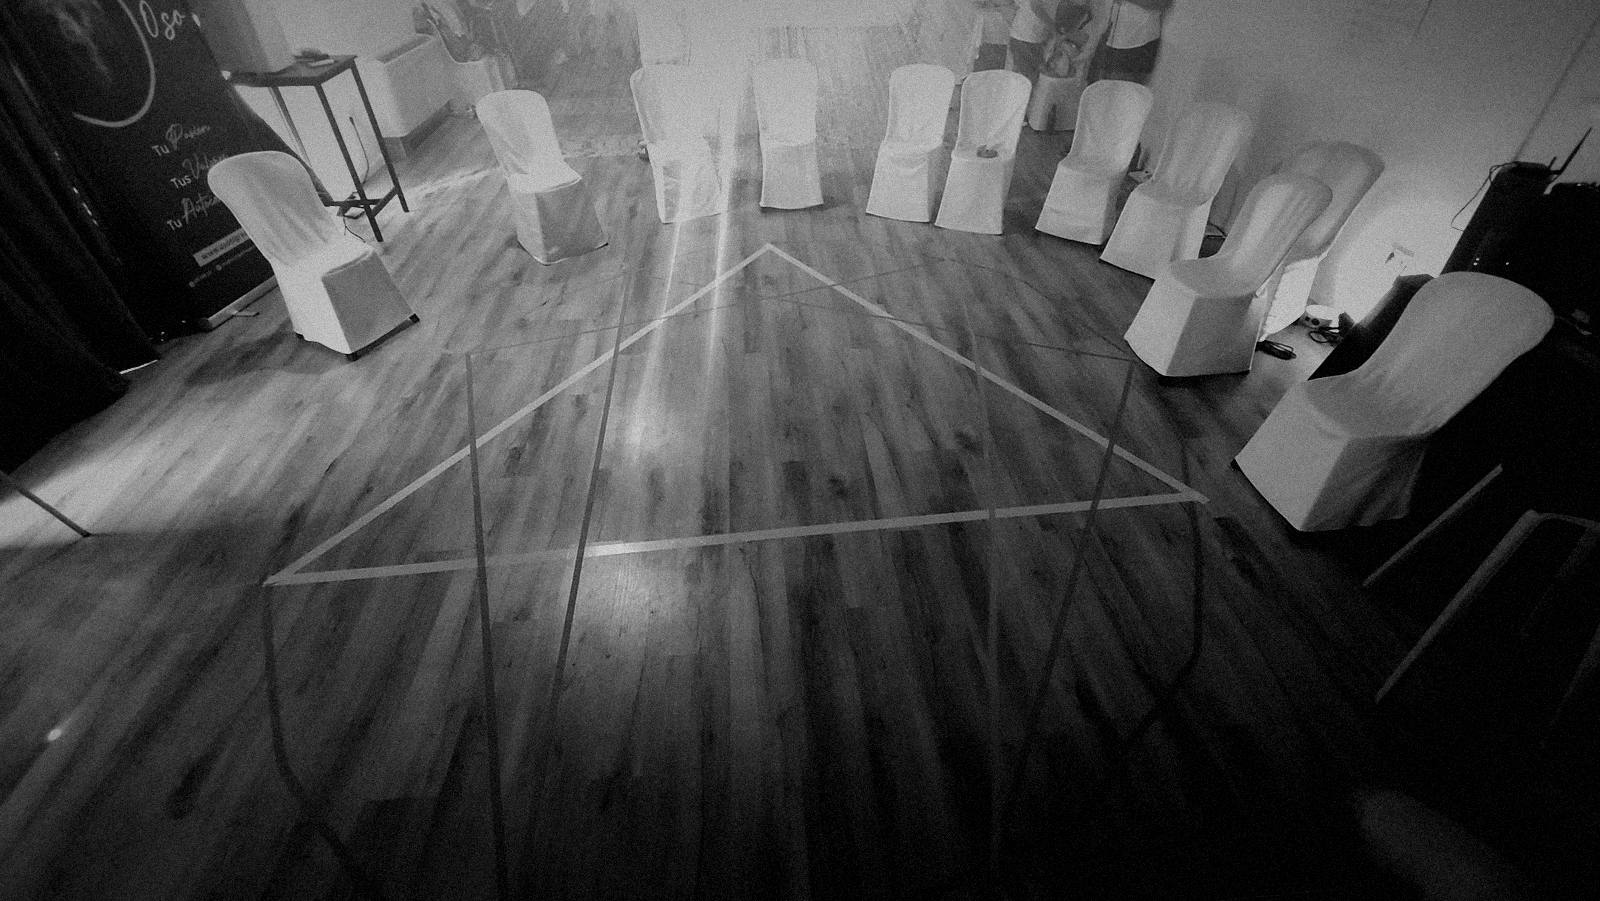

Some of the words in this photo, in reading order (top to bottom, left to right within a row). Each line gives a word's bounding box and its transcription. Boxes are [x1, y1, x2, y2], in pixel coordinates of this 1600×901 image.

[151, 144, 170, 157] Tu
[170, 174, 192, 189] Tus
[167, 218, 183, 231] Tu
